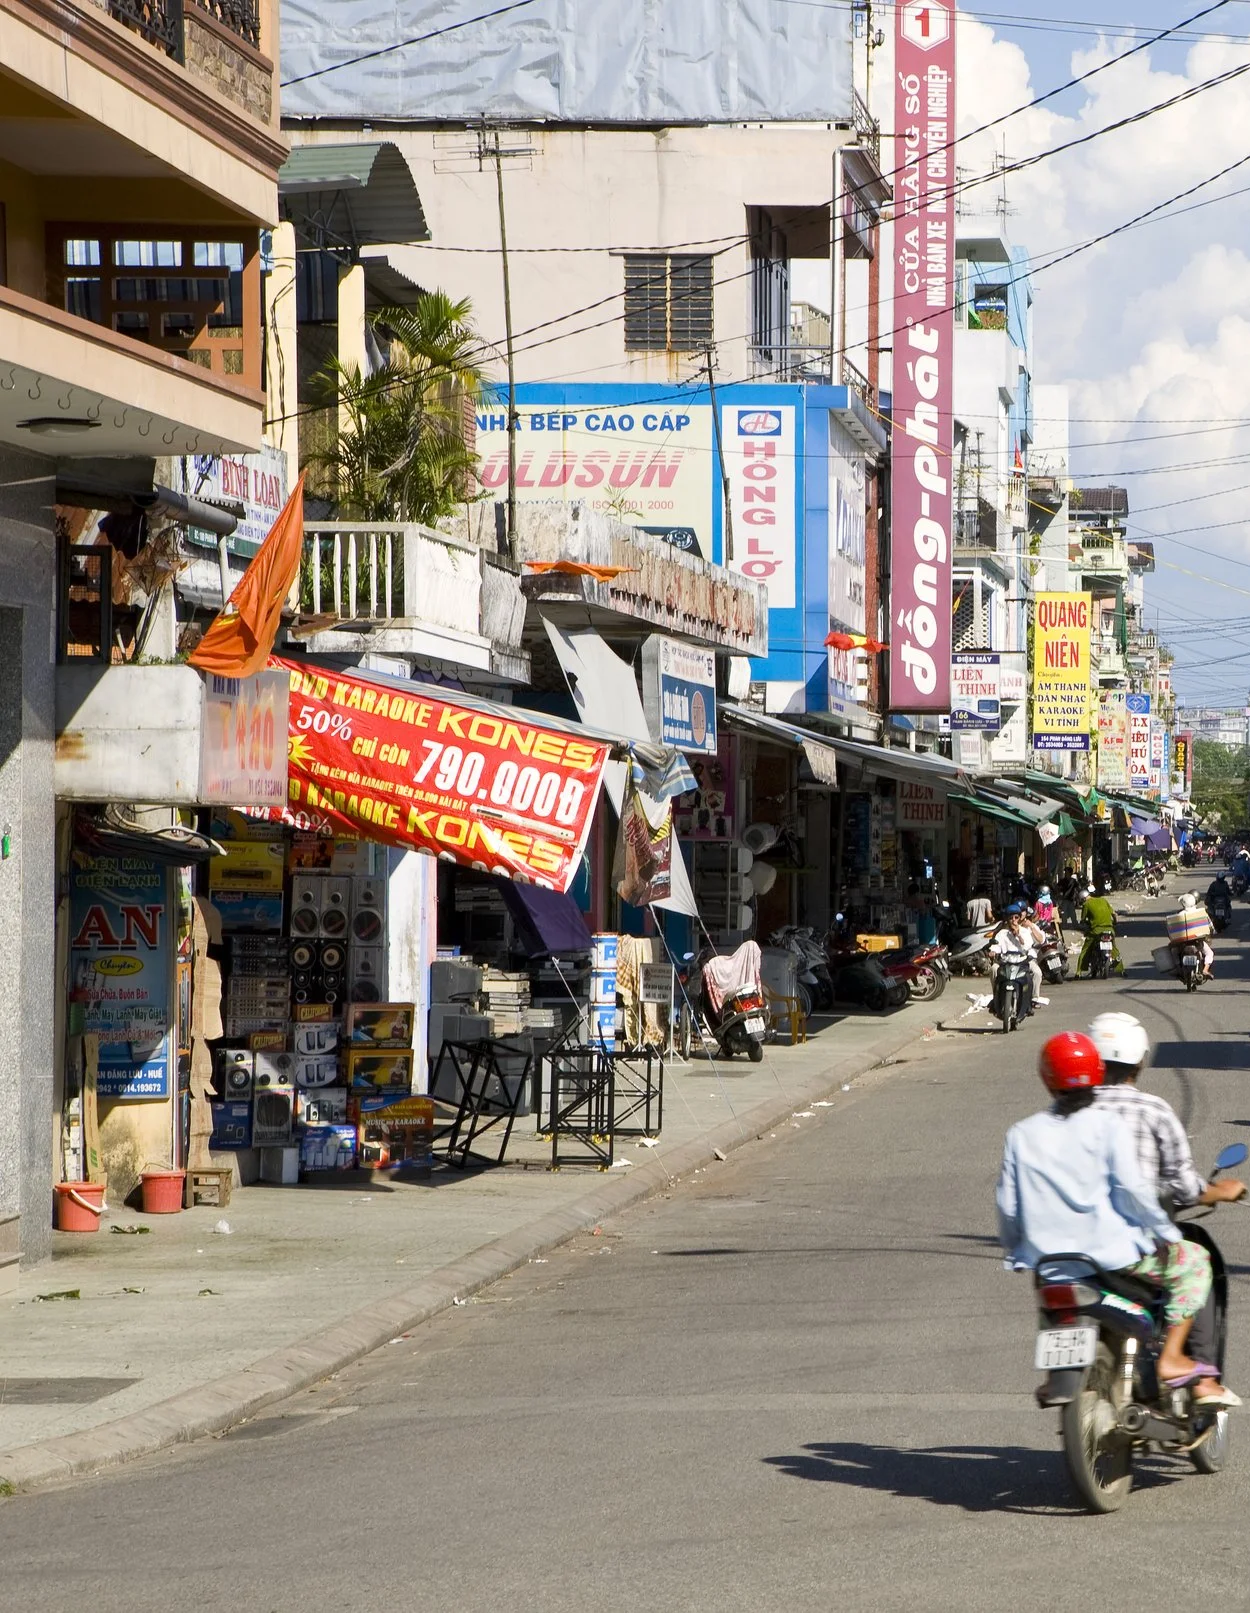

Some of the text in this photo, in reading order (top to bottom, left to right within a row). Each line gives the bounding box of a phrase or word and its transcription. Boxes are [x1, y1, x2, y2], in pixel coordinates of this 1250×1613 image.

[915, 8, 930, 37] 1
[899, 72, 921, 294] CỬA HÀNG SỐ
[922, 64, 952, 306] NHÀ BÁN XE MÁY CHUYÊN NGHIỆP
[531, 409, 577, 431] BẾP
[585, 414, 635, 432] CAO
[642, 409, 691, 432] CẤP
[1038, 600, 1087, 633] QUANG
[1045, 633, 1079, 668] NIÊN
[953, 665, 983, 681] LIÊN
[1054, 683, 1087, 691] THANH
[958, 683, 996, 698] THỊNH
[289, 670, 598, 771] DVD KARAOKE KONES
[297, 706, 353, 741] 50%
[955, 711, 969, 719] 166
[1039, 706, 1085, 715] KARAOKE
[352, 735, 586, 827] CHỈ CÒN 790.000Đ
[361, 776, 395, 793] KARAOKE
[307, 782, 401, 830] KARAOKE
[406, 803, 565, 873] KONES
[72, 904, 165, 950] AN
[395, 1116, 426, 1127] KARAOKE
